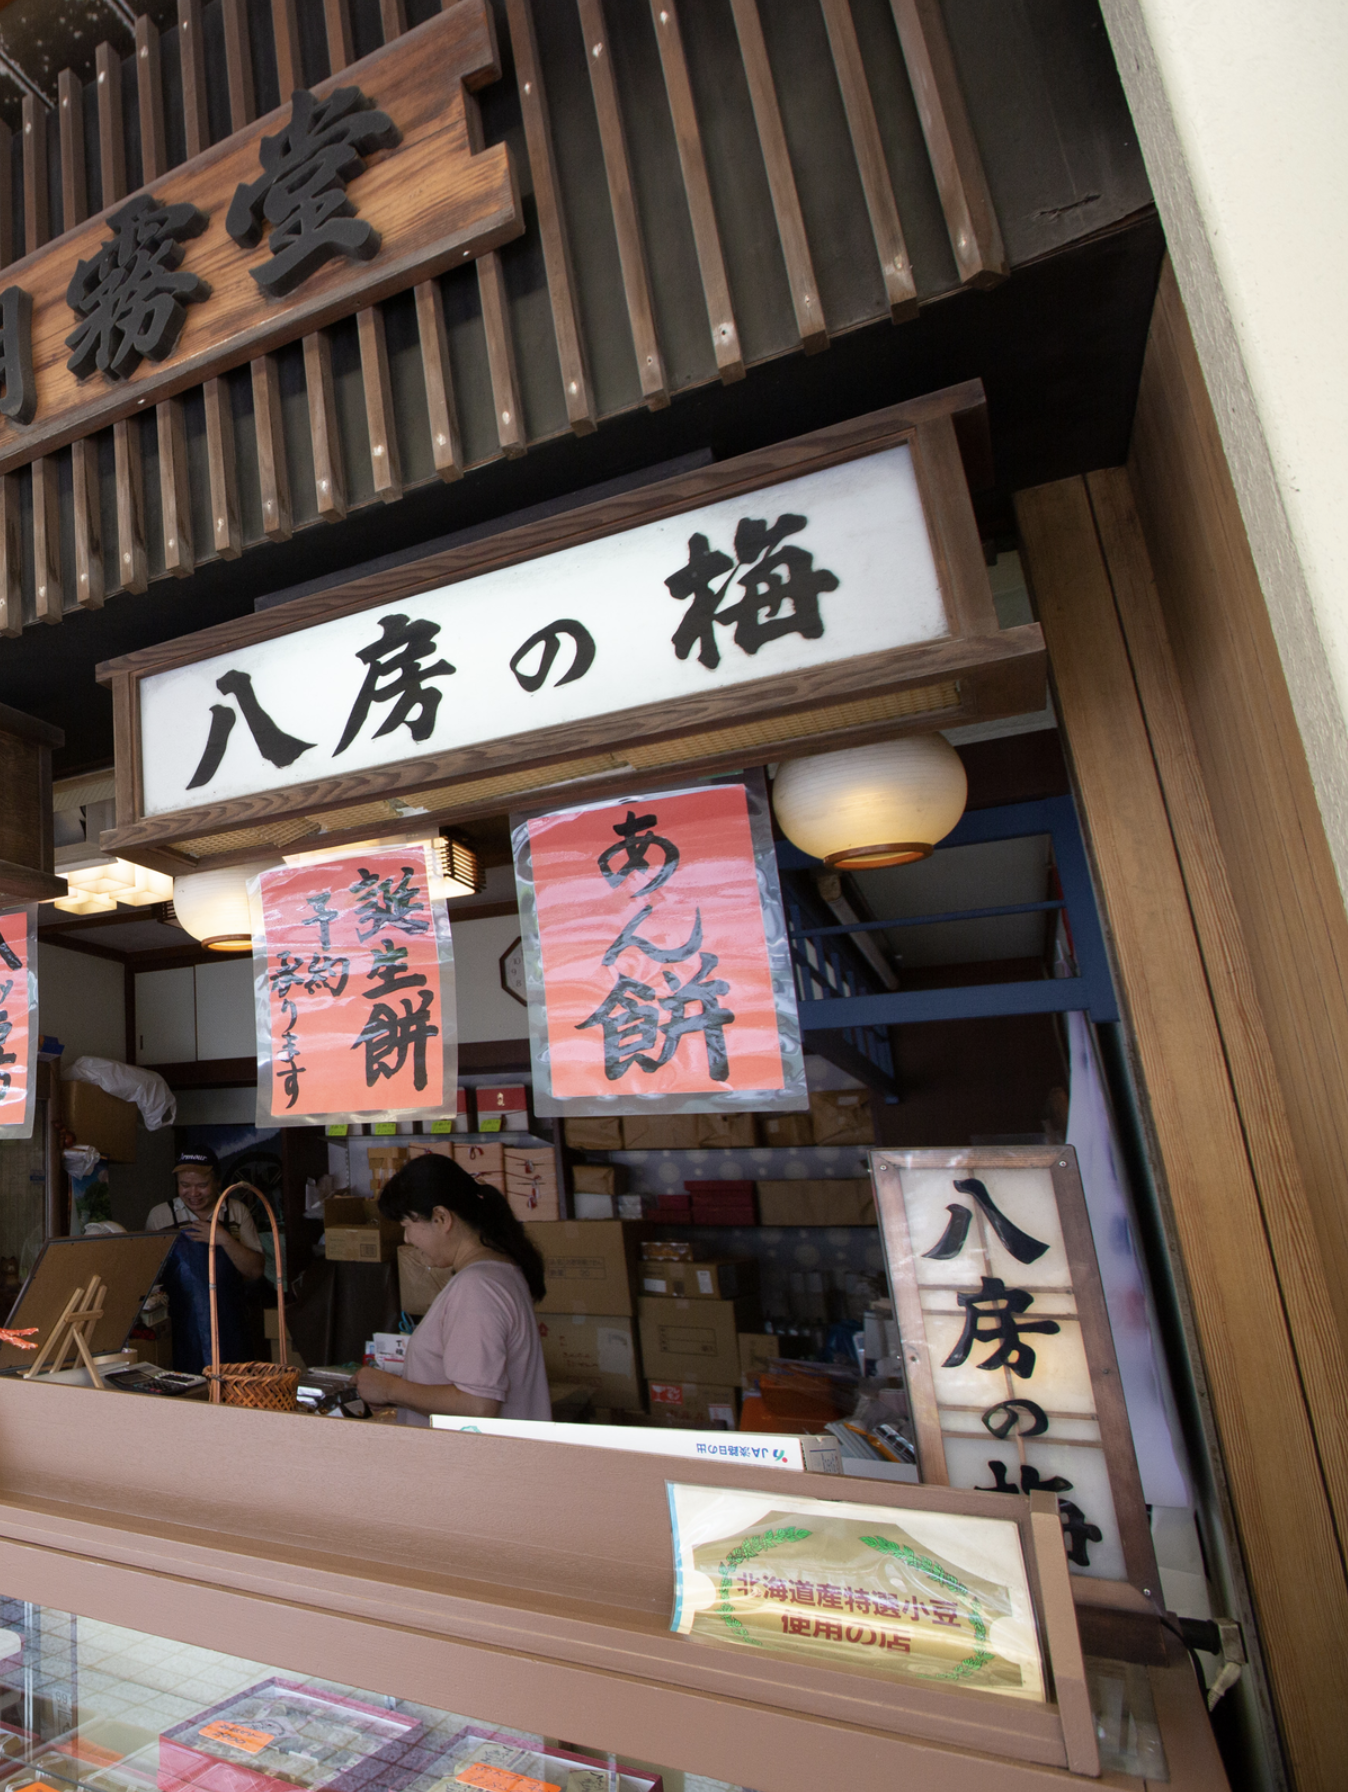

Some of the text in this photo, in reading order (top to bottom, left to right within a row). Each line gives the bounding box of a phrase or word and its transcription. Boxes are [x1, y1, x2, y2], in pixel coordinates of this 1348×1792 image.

[185, 512, 841, 790] 八房の梅
[349, 866, 439, 1091] 誕生餅
[574, 811, 735, 1082] あん餅
[697, 1442, 769, 1461] JA淡路日の出
[736, 1572, 962, 1629] 北海道産特選小豆
[781, 1609, 912, 1655] 使用の店
